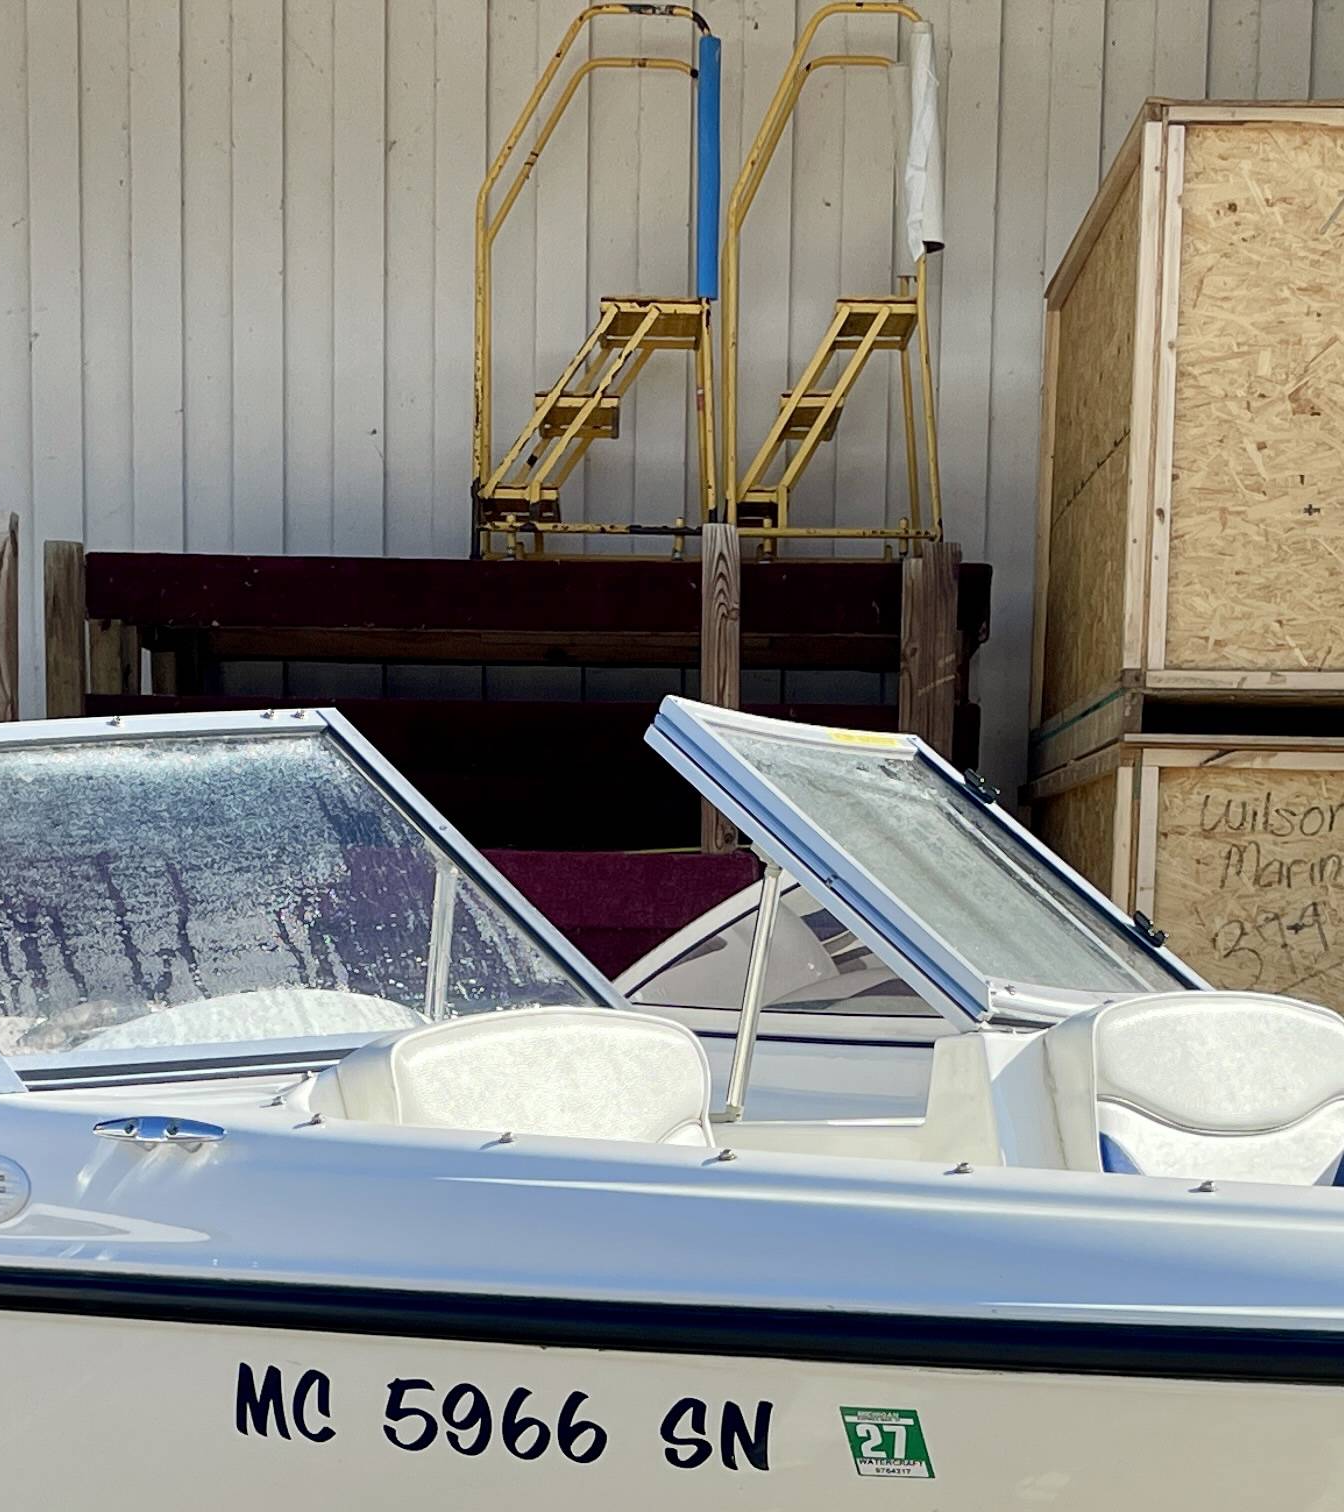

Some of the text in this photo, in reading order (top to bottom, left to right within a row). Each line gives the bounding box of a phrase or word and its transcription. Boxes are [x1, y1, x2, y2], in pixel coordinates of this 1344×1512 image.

[234, 1361, 775, 1473] MC 5966 SN
[855, 1423, 907, 1459] 27
